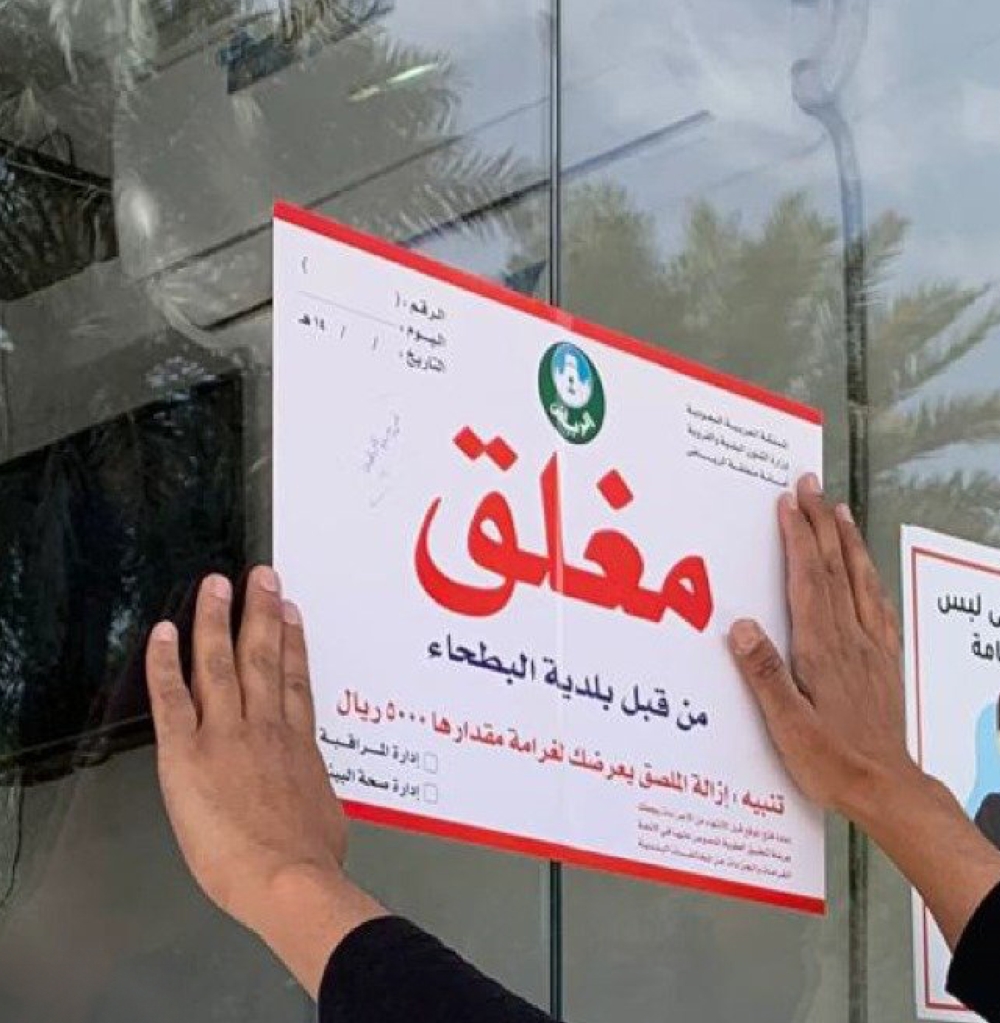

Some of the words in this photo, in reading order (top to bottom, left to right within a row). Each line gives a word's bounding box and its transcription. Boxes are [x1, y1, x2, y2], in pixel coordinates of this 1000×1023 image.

[415, 426, 714, 633] مغلق
[937, 593, 981, 622] لبس
[427, 634, 535, 685] البطحاء
[543, 656, 615, 711] بلدية
[336, 688, 381, 723] ريال
[621, 684, 670, 722] قبل
[675, 699, 709, 731] من
[431, 711, 504, 745] مقدارها
[508, 728, 565, 763] لغرامة
[569, 748, 634, 787] يعرضك
